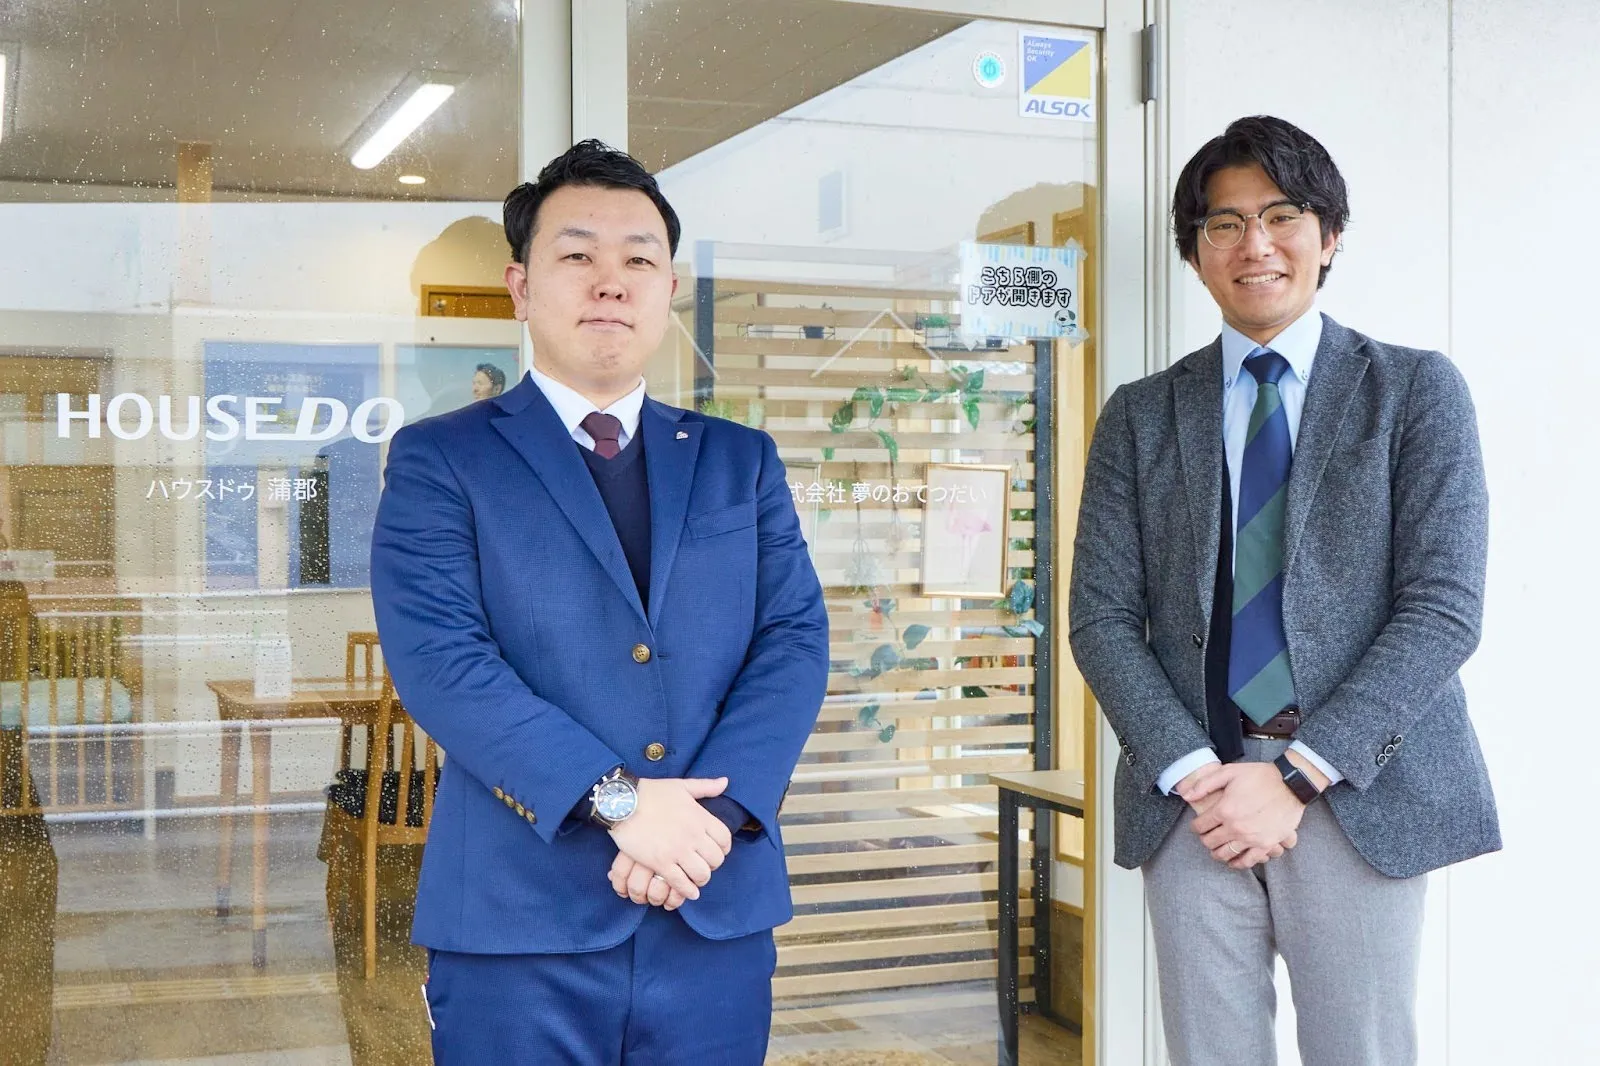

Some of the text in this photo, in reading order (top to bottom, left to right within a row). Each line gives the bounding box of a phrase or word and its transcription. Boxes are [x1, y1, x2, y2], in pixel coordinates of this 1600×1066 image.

[1025, 99, 1091, 118] ALSOK
[981, 266, 1057, 287] こちら側の
[968, 286, 1071, 308] ドアが開きます
[146, 477, 317, 501] ハウスドゥ 蒲郡
[852, 482, 986, 503] 夢のおてつだい
